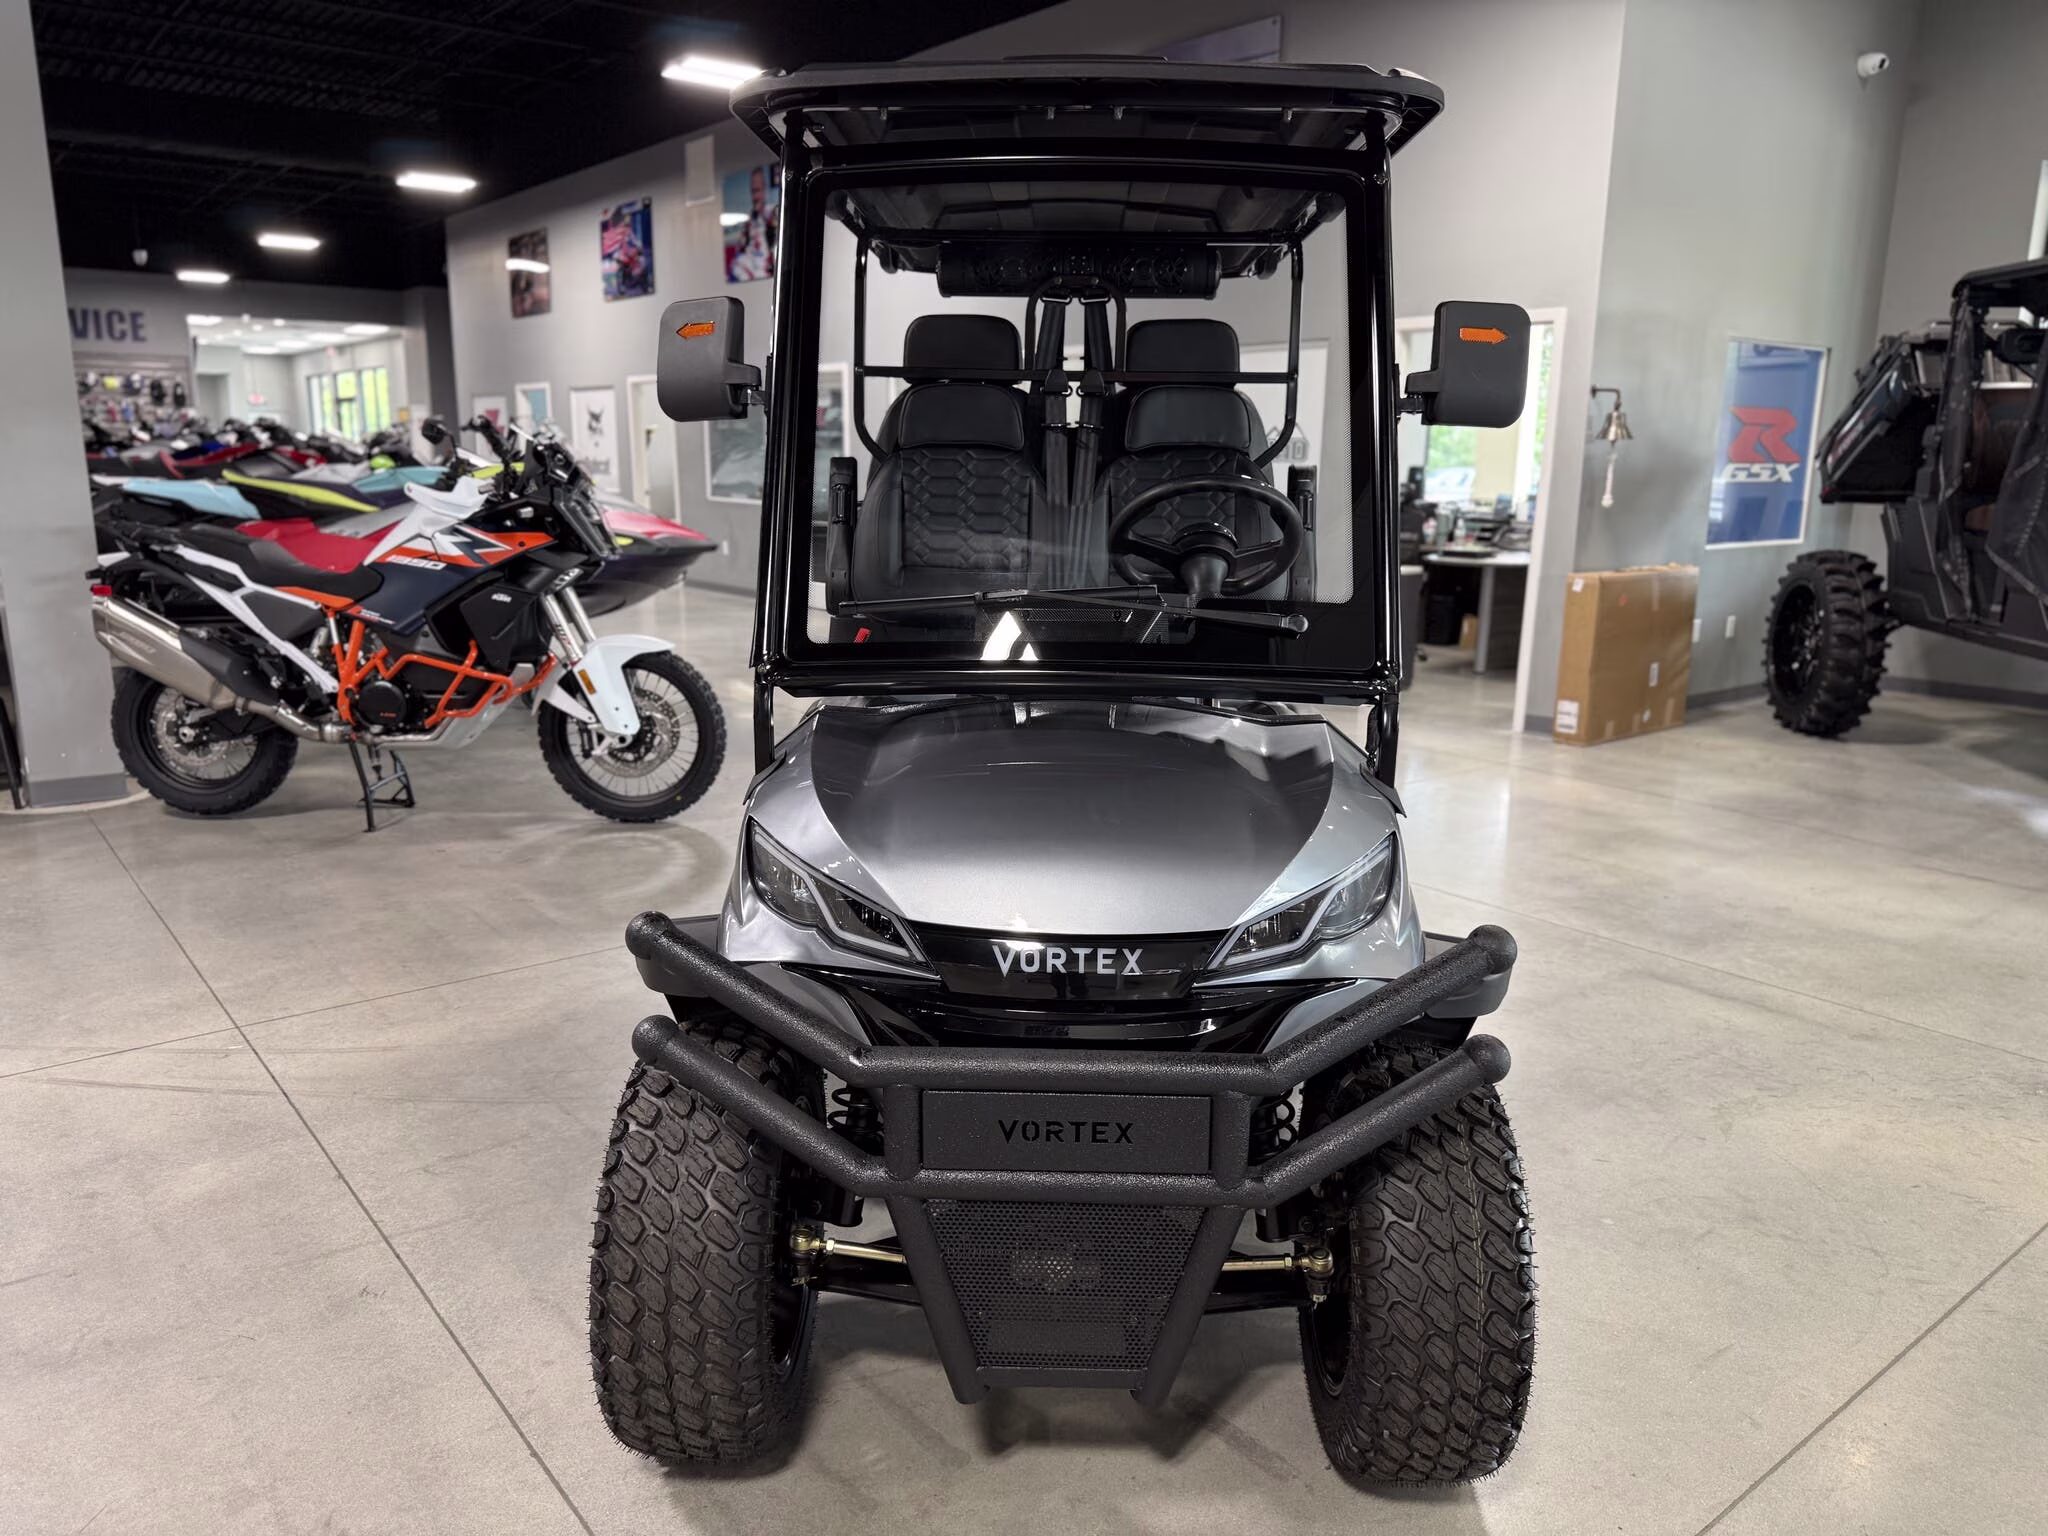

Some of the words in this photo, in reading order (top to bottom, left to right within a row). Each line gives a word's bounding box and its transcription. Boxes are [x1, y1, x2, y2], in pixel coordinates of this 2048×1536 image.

[68, 307, 147, 342] VICE
[1719, 462, 1801, 483] GSX
[992, 944, 1144, 977] VORTEX
[998, 1119, 1134, 1145] VORTEX
